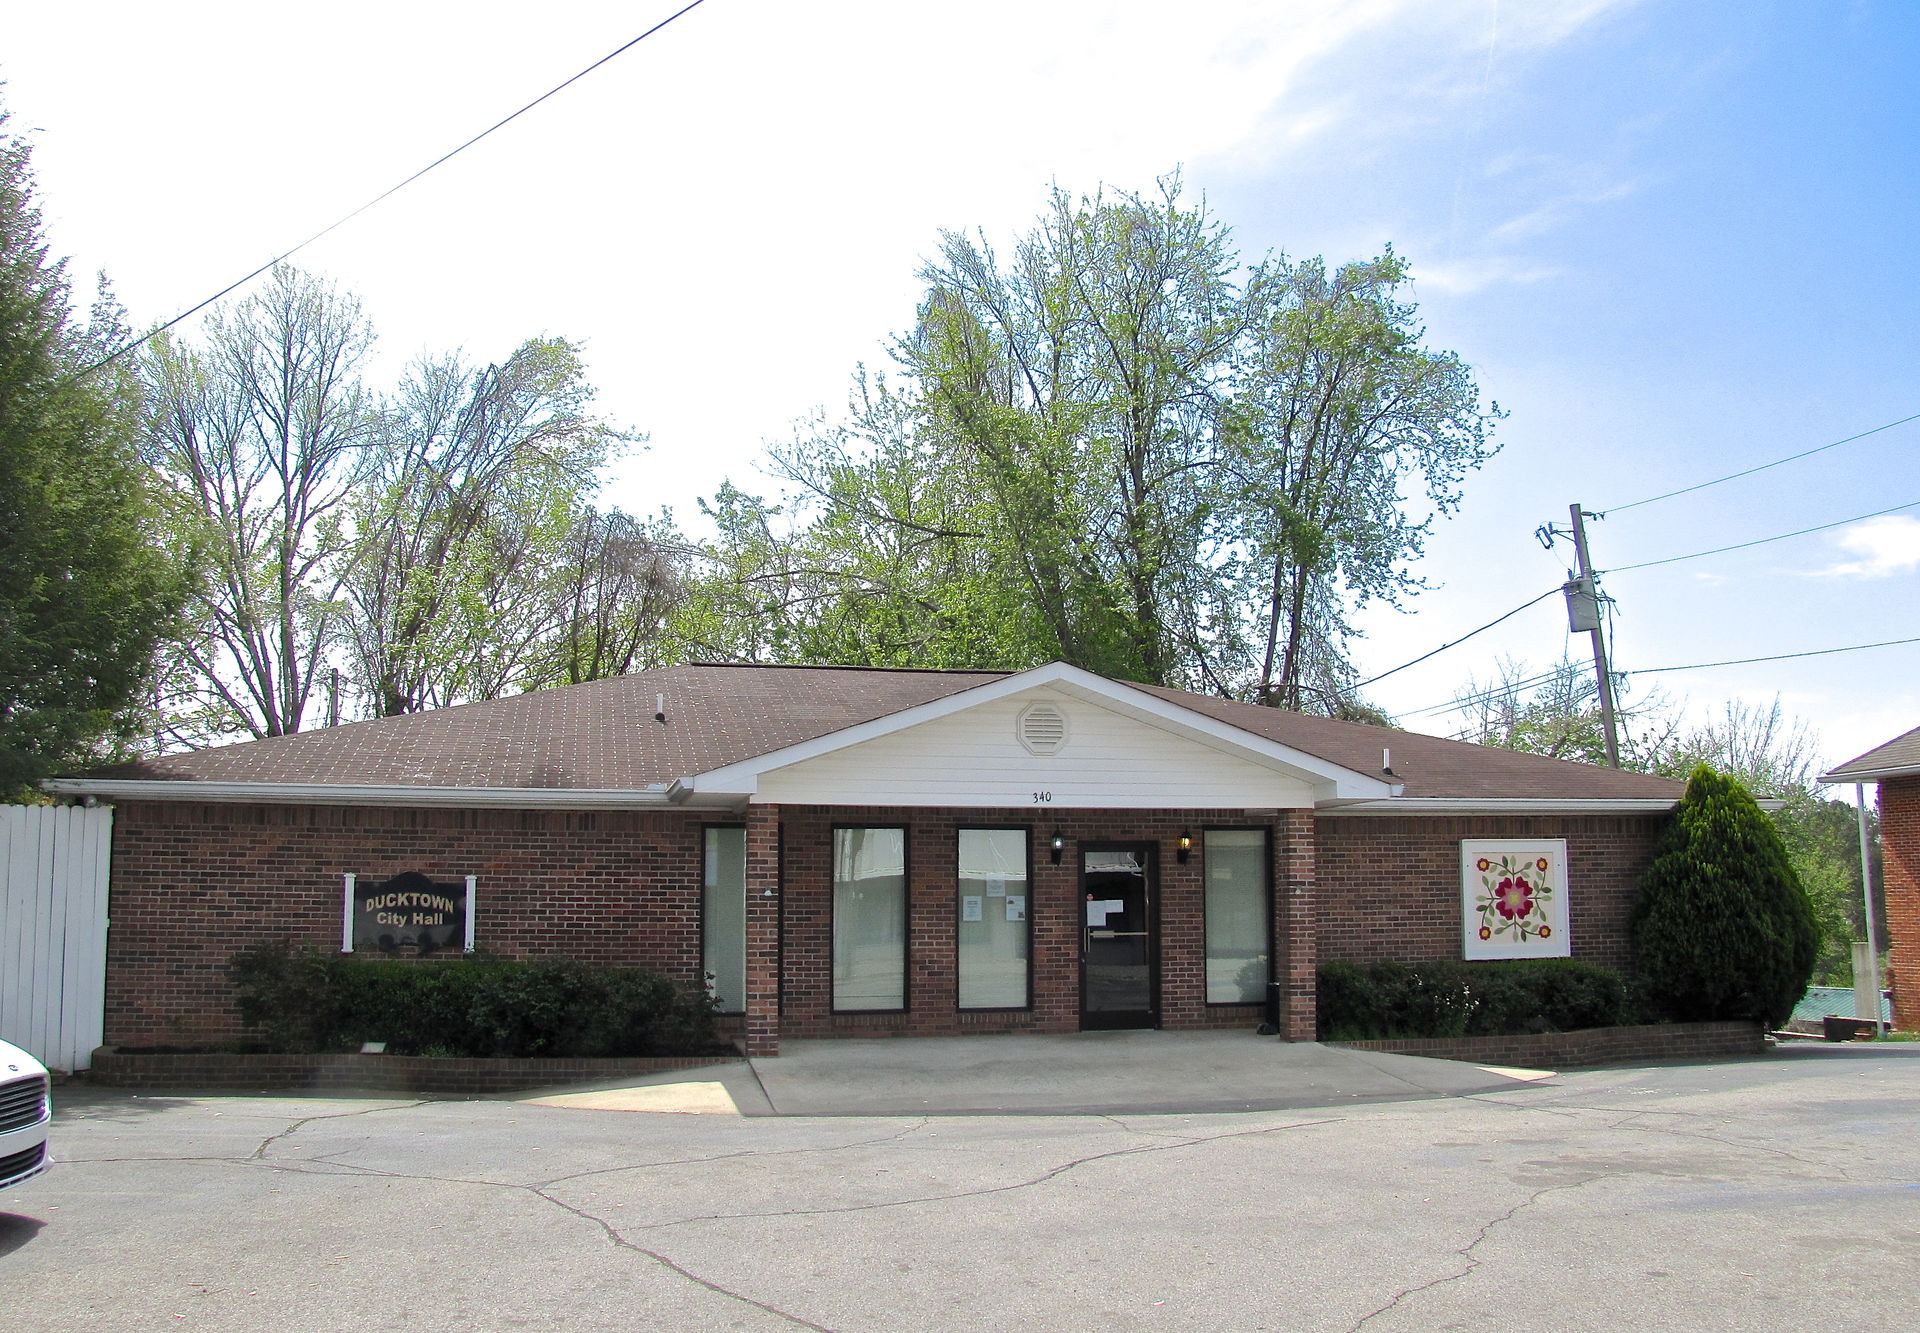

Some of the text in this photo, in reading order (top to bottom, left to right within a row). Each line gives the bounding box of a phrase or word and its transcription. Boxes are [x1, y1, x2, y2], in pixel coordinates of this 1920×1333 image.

[1032, 791, 1052, 804] 340
[366, 892, 454, 914] DUCKTOWN
[376, 912, 443, 928] City Hall
